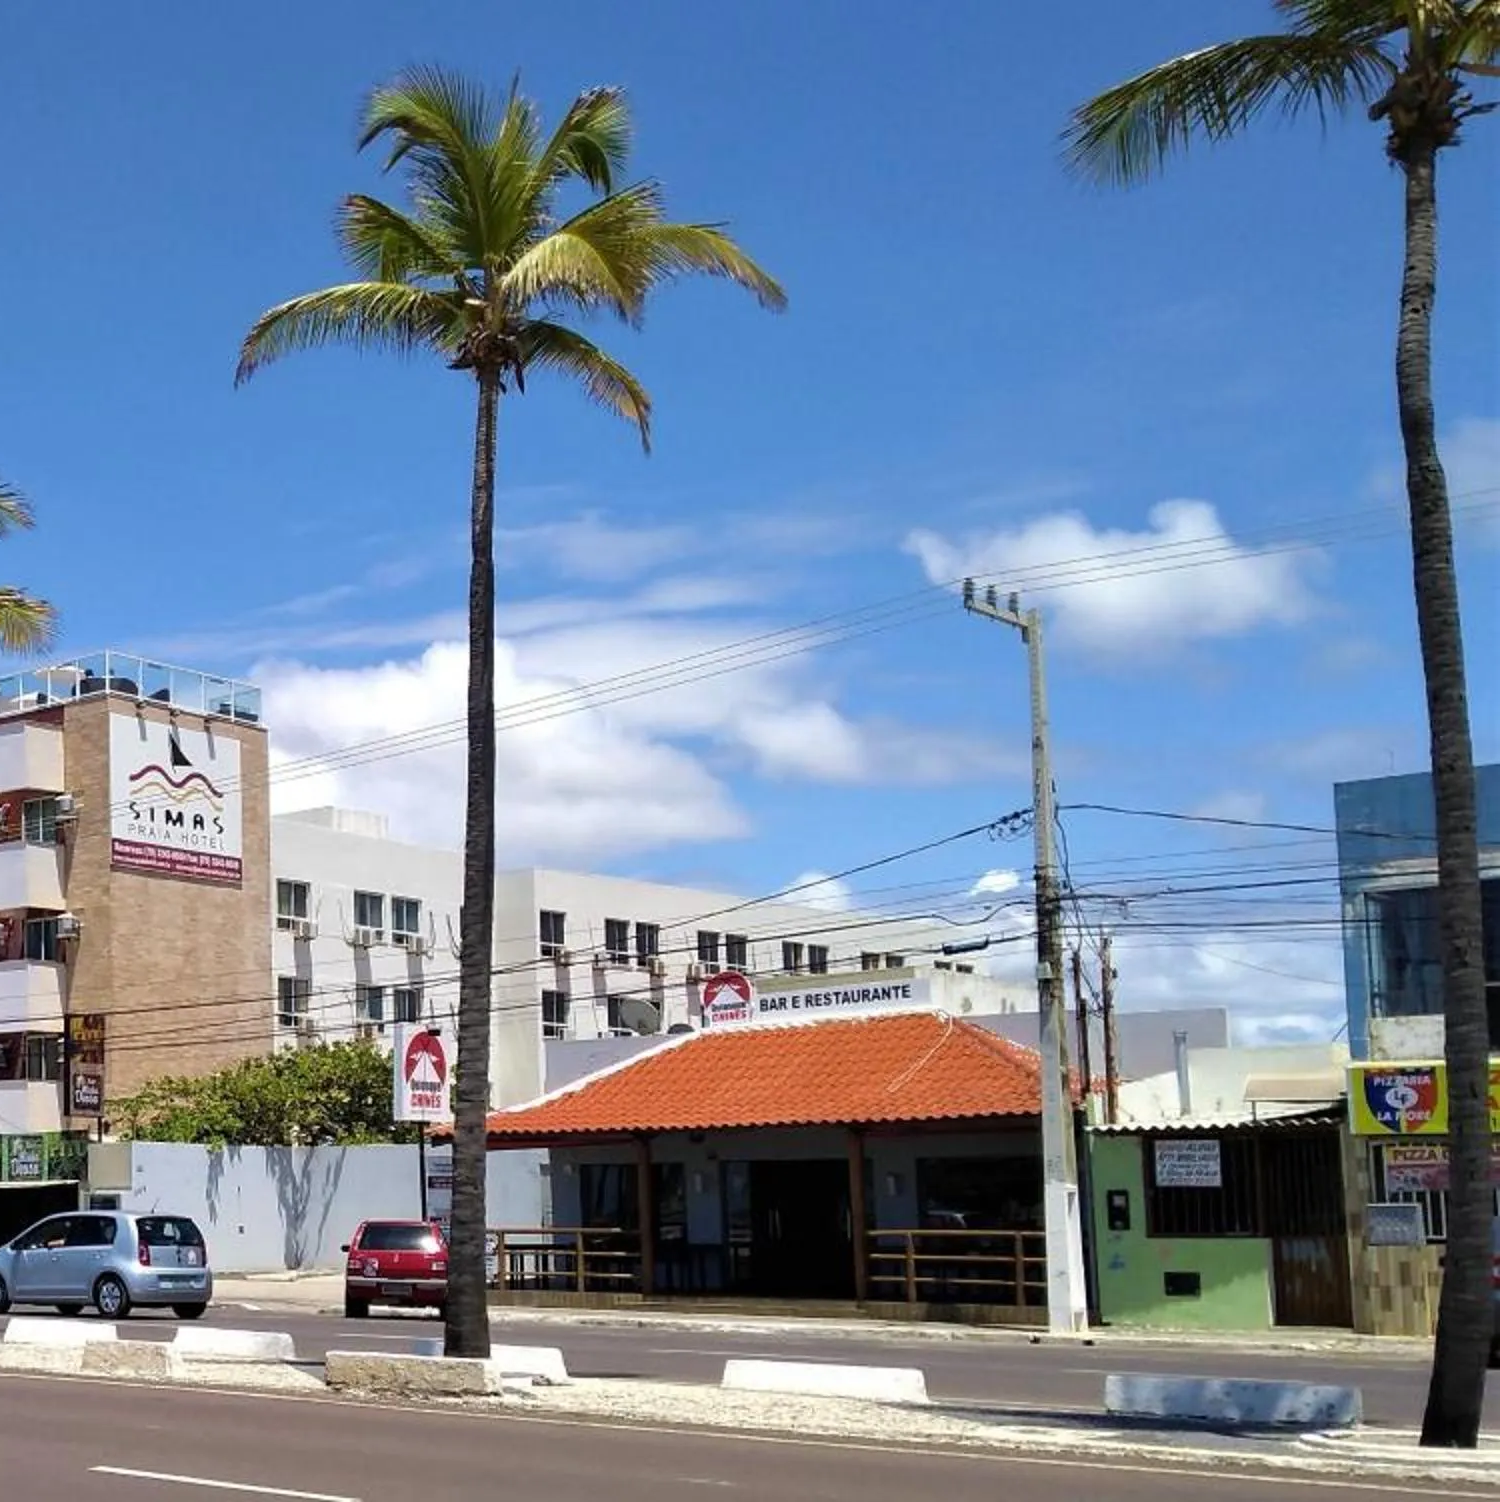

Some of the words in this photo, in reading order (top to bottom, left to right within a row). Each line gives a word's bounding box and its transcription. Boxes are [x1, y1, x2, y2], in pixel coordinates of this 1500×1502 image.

[129, 801, 224, 835] SIMAS
[127, 823, 171, 841] PRAIA
[181, 833, 225, 851] HOTEL
[759, 998, 786, 1012] BAR
[791, 996, 800, 1009] E
[804, 984, 911, 1008] RESTAURANTE
[1373, 1075, 1432, 1087] PIZZARIA
[1377, 1111, 1393, 1121] LA
[1395, 1111, 1431, 1121] FORE
